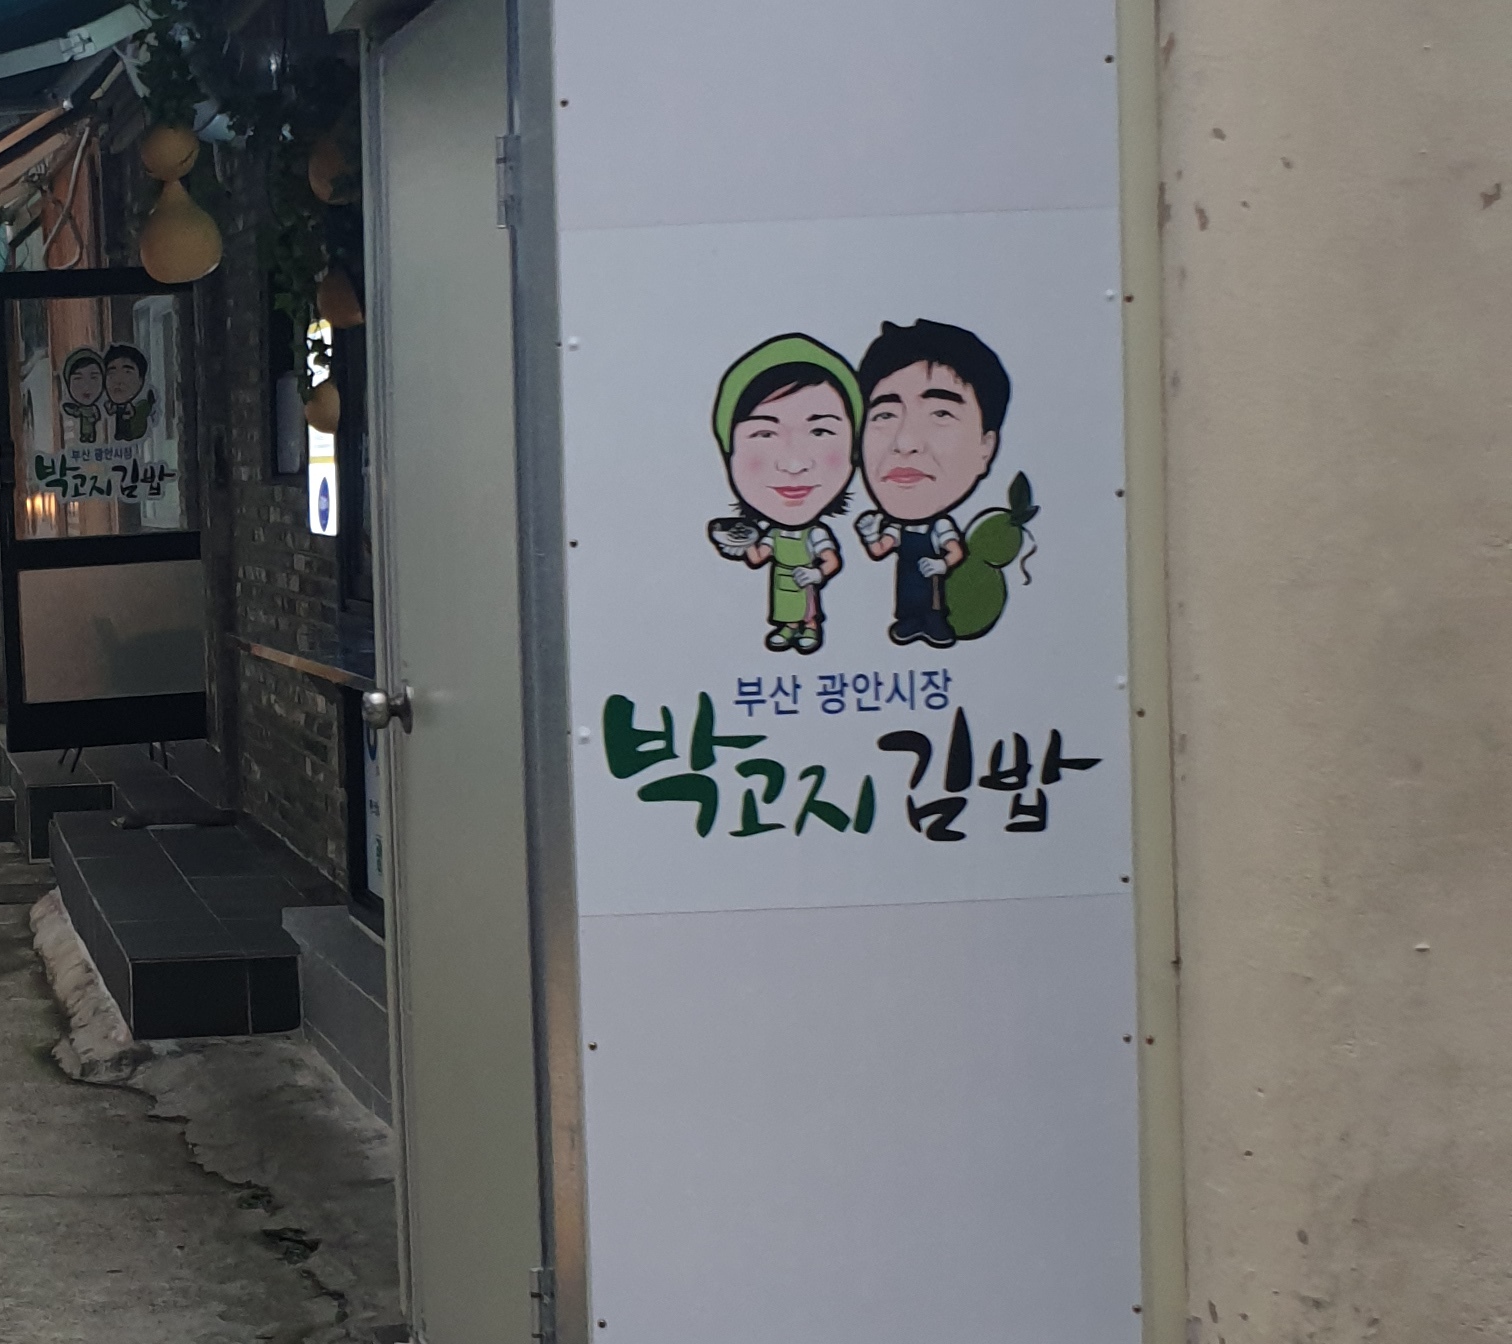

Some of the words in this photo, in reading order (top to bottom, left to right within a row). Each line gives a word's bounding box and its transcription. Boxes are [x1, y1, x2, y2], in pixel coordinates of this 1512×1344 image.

[72, 449, 90, 462] 부산
[733, 675, 802, 717] 부산
[815, 669, 953, 715] 광안시장
